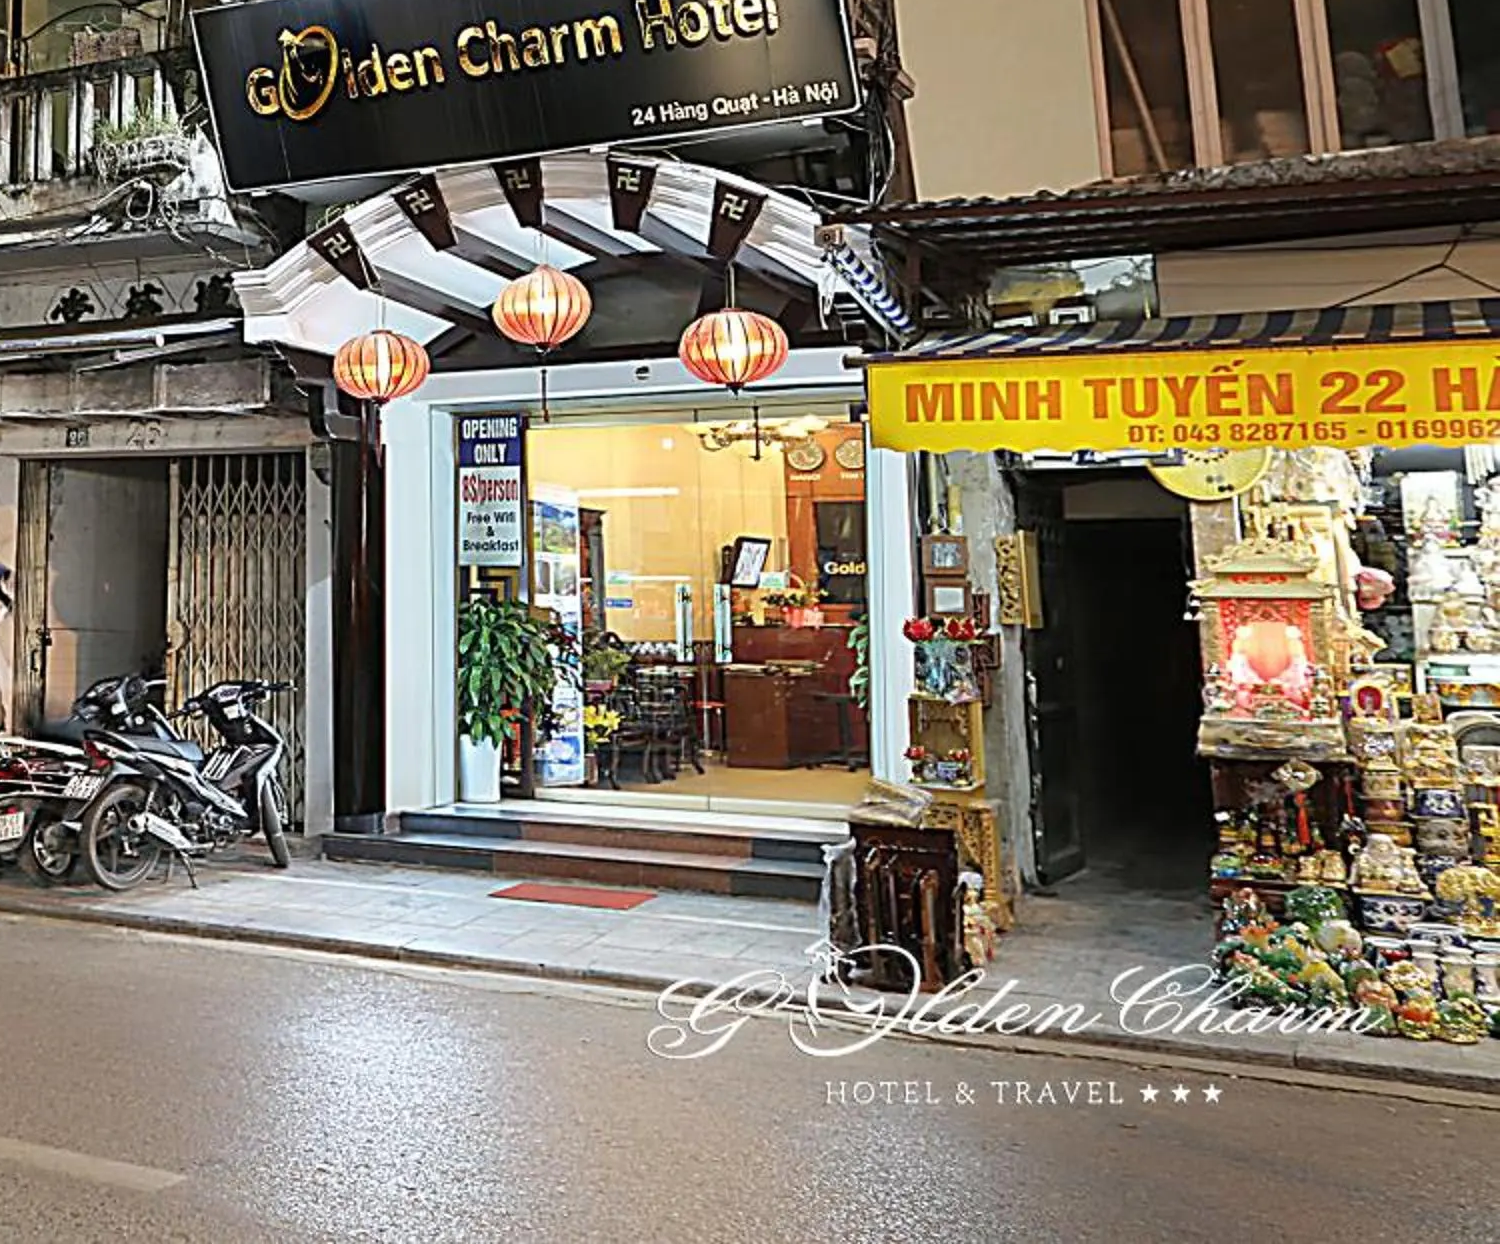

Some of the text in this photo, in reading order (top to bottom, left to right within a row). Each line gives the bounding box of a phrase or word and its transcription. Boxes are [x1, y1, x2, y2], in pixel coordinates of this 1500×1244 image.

[457, 11, 623, 77] Charm
[632, 106, 655, 126] 24
[660, 101, 708, 122] Hàng
[712, 93, 759, 115] Quạt
[773, 85, 800, 107] Hà
[805, 81, 839, 105] Nội
[905, 380, 1062, 423] MINH
[1084, 359, 1294, 419] TUYẾN
[1319, 369, 1407, 415] 22
[462, 417, 518, 439] OPENING
[1173, 423, 1221, 442] 043
[1229, 421, 1347, 441] 8287165
[473, 443, 507, 464] ONLY
[467, 511, 491, 524] Free
[463, 539, 519, 552] Breakfast
